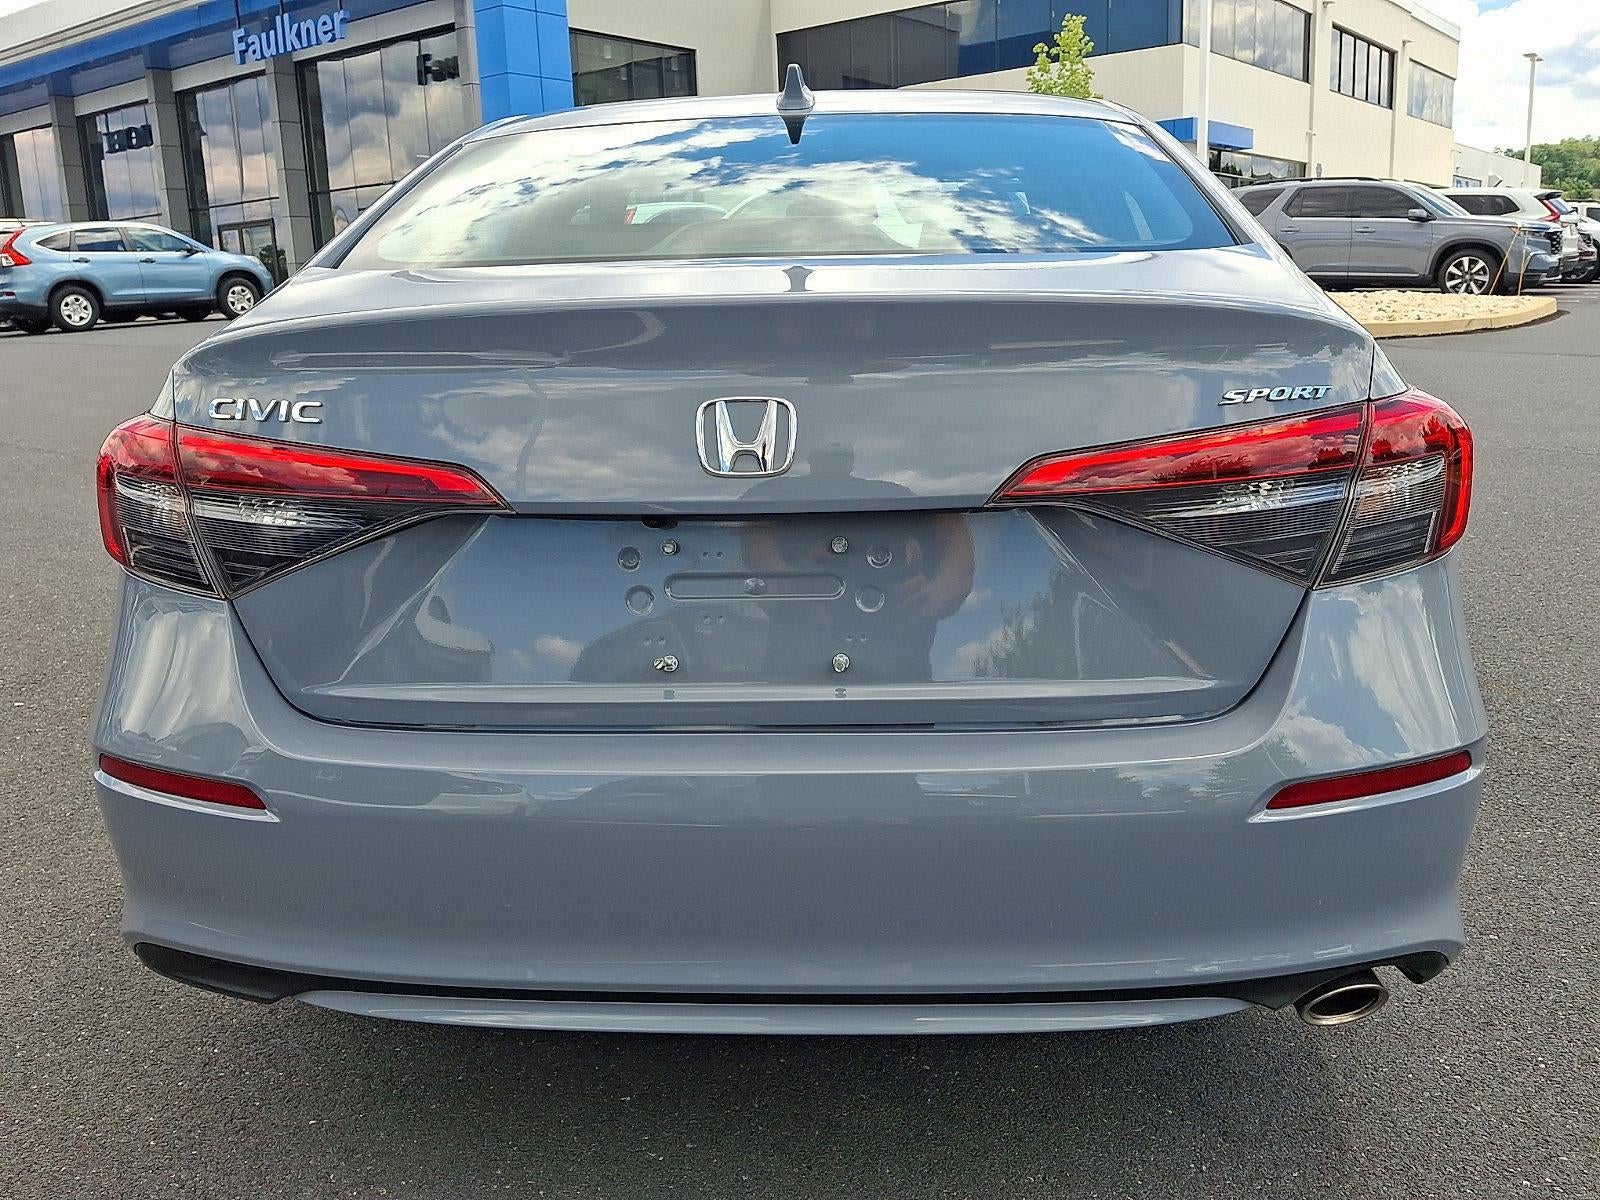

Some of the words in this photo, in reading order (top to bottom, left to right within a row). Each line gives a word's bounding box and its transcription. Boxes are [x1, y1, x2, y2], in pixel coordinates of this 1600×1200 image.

[232, 9, 348, 65] Faulkner
[1218, 385, 1333, 405] SPORT
[208, 398, 322, 424] CIVIC
